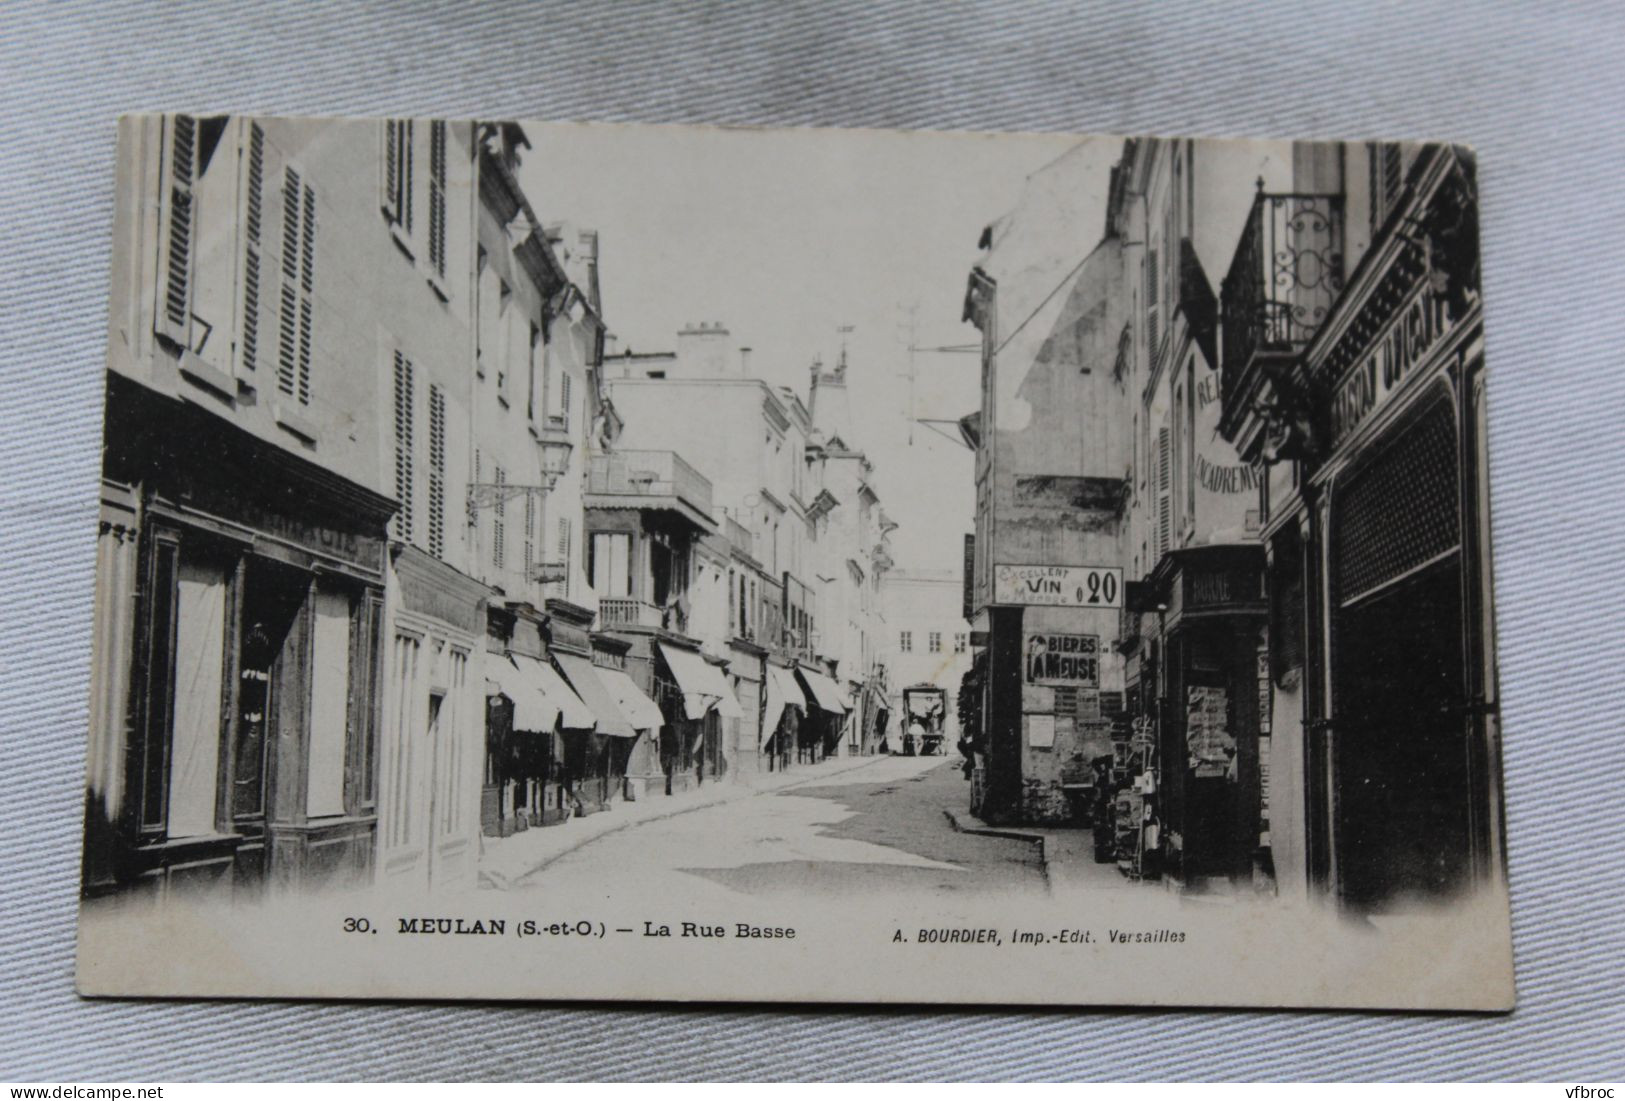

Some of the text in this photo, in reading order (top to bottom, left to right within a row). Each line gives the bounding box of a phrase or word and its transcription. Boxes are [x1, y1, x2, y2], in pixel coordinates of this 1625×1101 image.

[1026, 577, 1061, 594] VIN
[1087, 571, 1117, 603] 20
[1045, 653, 1097, 681] MEUSE
[343, 917, 796, 940] 30. MEULAN (S.-et-O.) La Rue Basse
[892, 929, 1186, 946] A. BOURDIER, Imp.-Edit. Versailles
